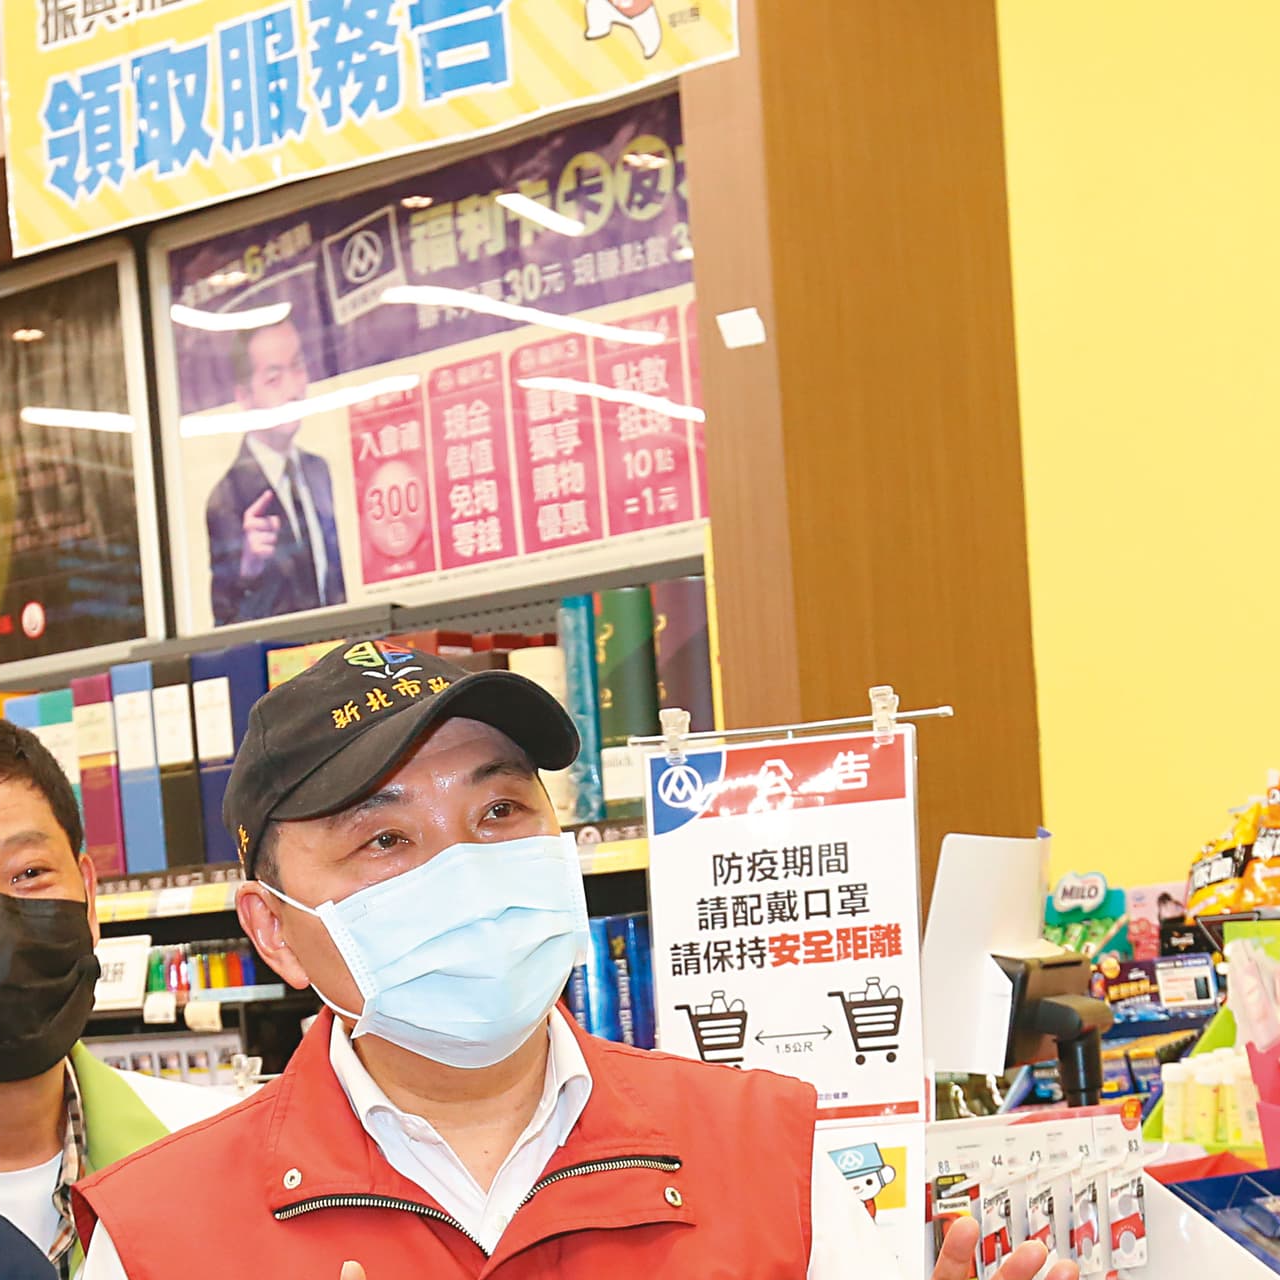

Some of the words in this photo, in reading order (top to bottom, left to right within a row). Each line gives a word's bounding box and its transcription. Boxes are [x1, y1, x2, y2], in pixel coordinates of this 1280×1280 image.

[41, 0, 511, 199] 領取服務台
[408, 134, 687, 276] 福利卡卡友
[611, 356, 669, 392] 點數
[442, 399, 492, 441] 現金
[527, 419, 582, 462] 獨享
[445, 440, 495, 480] 儲值
[531, 460, 587, 502] 購物
[624, 447, 676, 480] 10點
[368, 480, 419, 521] 300
[449, 480, 499, 520] 免掏
[536, 500, 589, 542] 優惠
[452, 517, 503, 557] 零錢
[757, 749, 872, 802] 公告
[711, 840, 852, 887] 防疫期間
[696, 882, 872, 933] 請配戴口罩
[669, 922, 904, 978] 請保持安全距離
[774, 1041, 814, 1055] 1.5公尺
